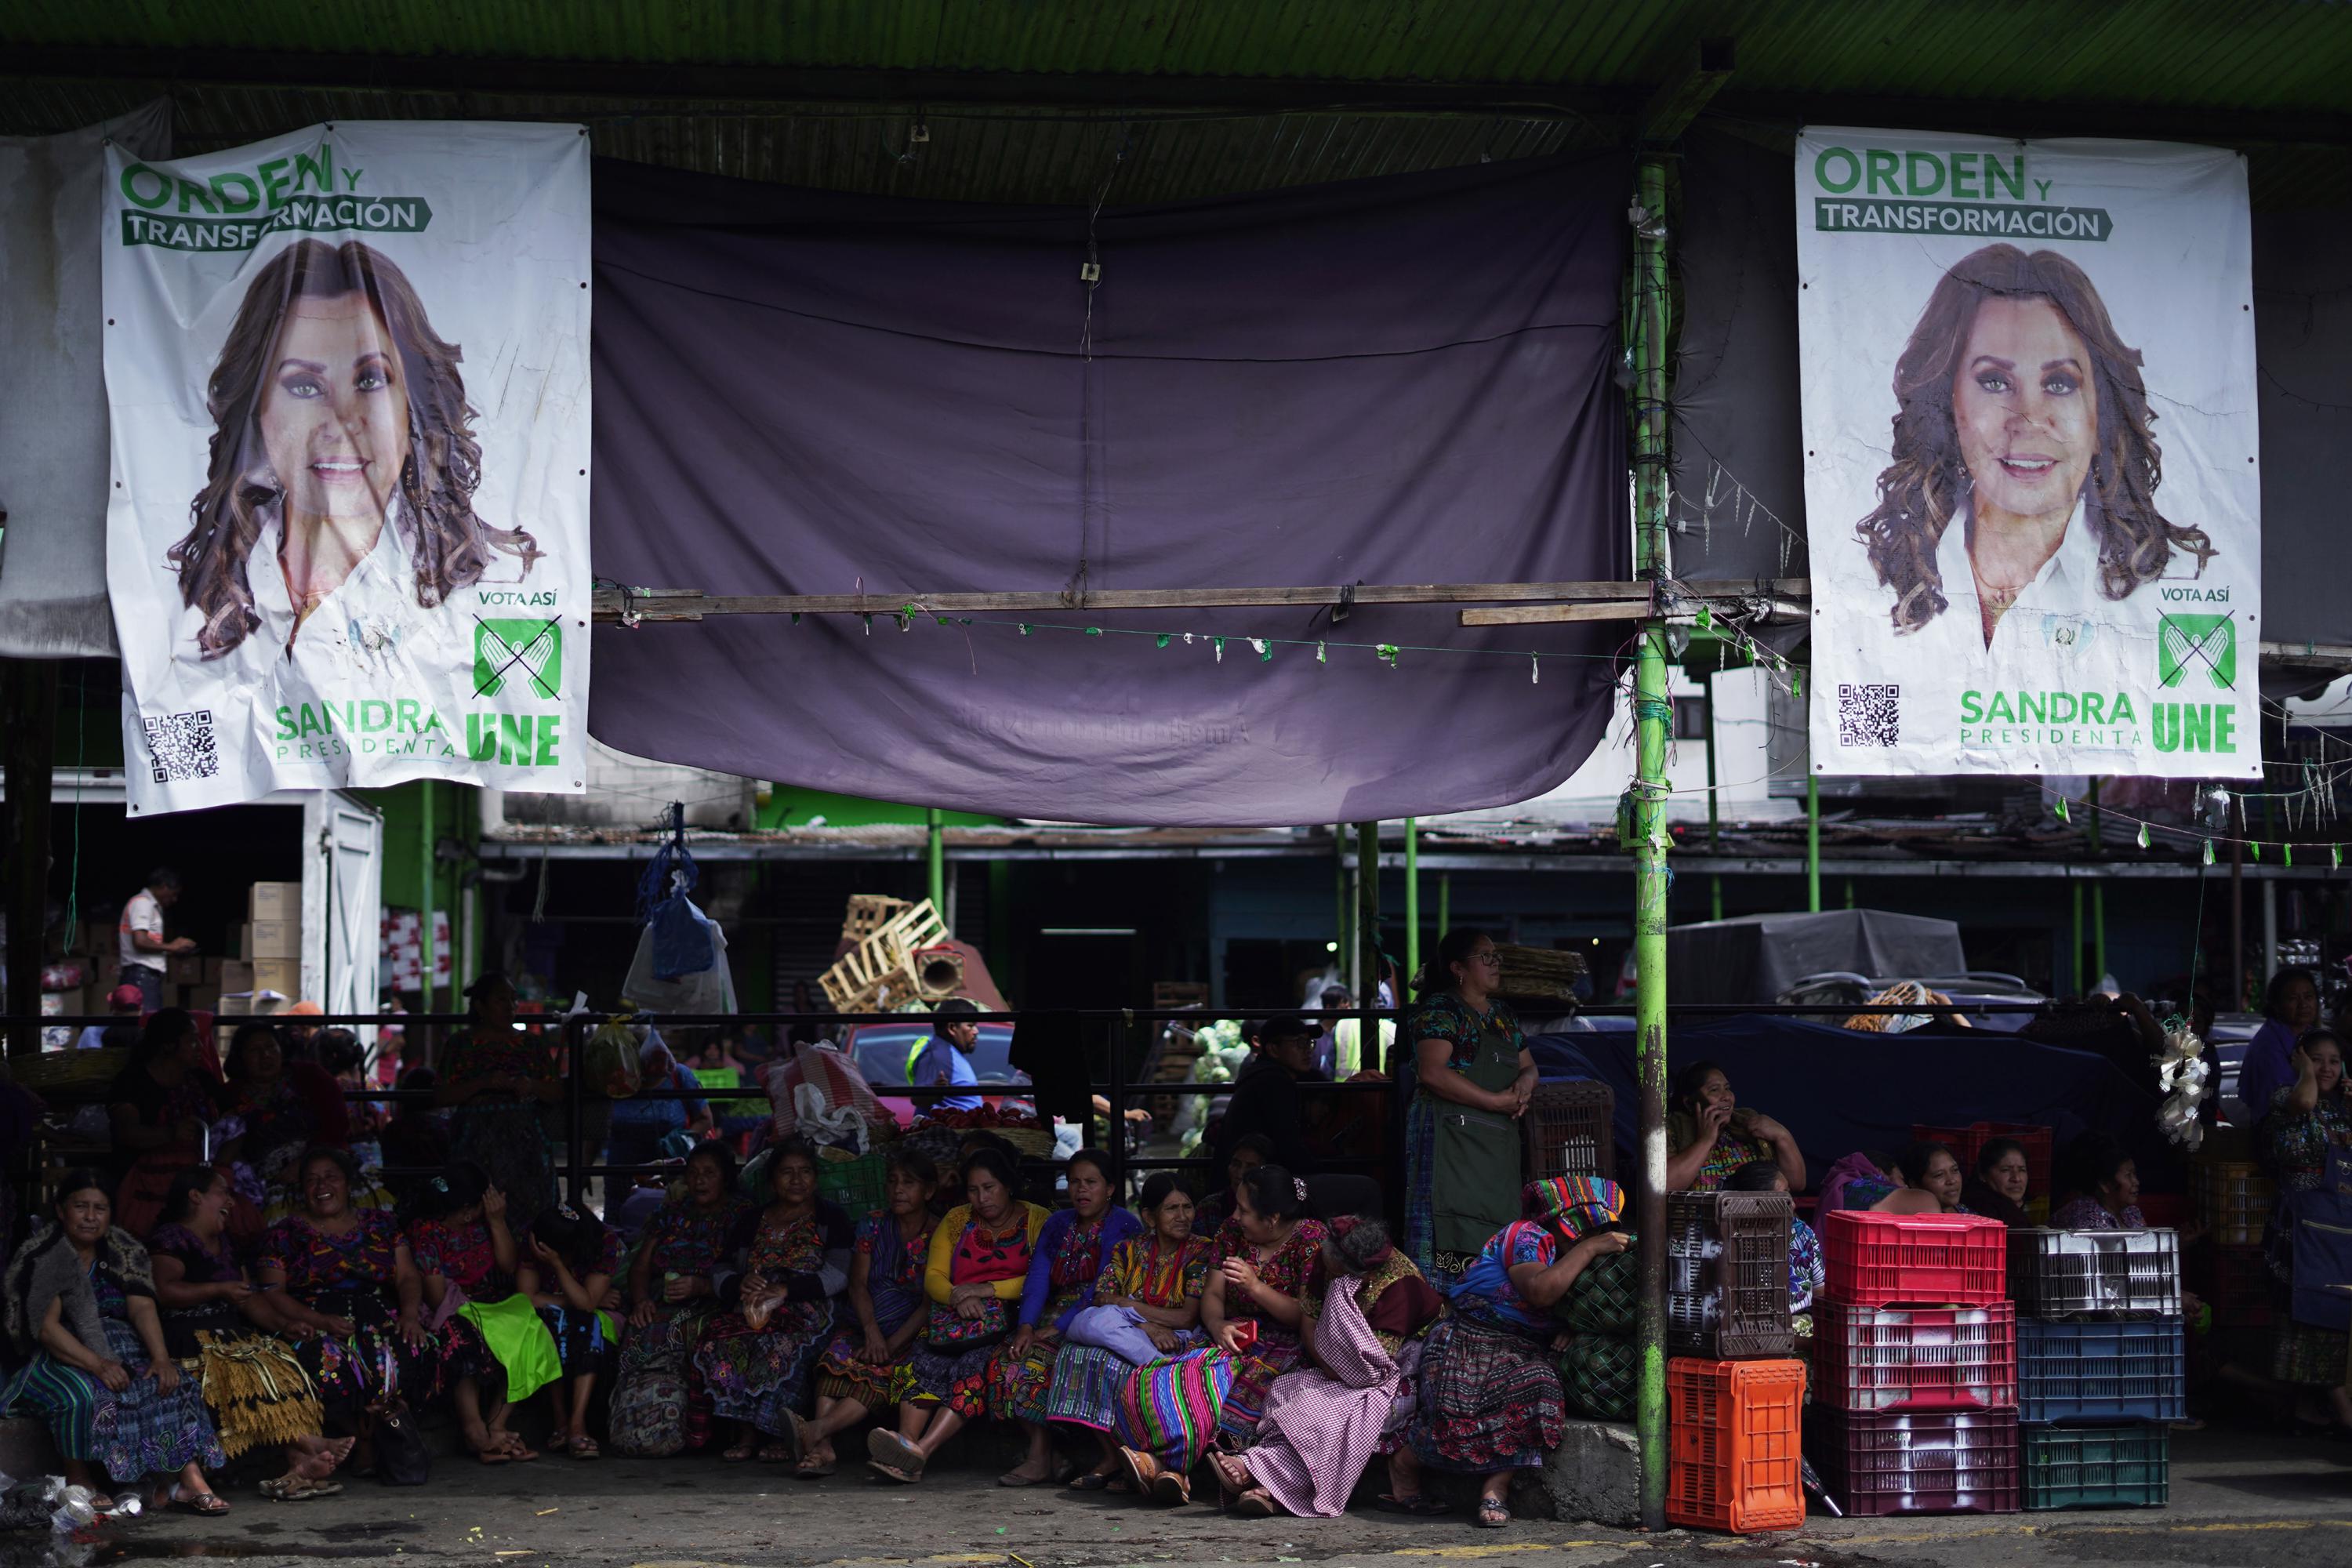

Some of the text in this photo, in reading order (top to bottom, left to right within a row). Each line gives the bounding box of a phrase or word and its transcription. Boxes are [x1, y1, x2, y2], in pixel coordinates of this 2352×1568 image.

[120, 143, 364, 214] ORDEN Y
[1814, 146, 2053, 201] ORDEN Y
[1821, 204, 2100, 237] TRANSFORMACIÓN
[478, 588, 557, 606] VOTA ASÍ
[2161, 586, 2230, 603] VOTA ASÍ
[276, 699, 451, 741] SANDRA
[1960, 690, 2139, 725] SANDRA
[466, 713, 561, 767] UNE
[1960, 728, 2143, 746] PRESIDENTA
[2152, 702, 2237, 753] UNE
